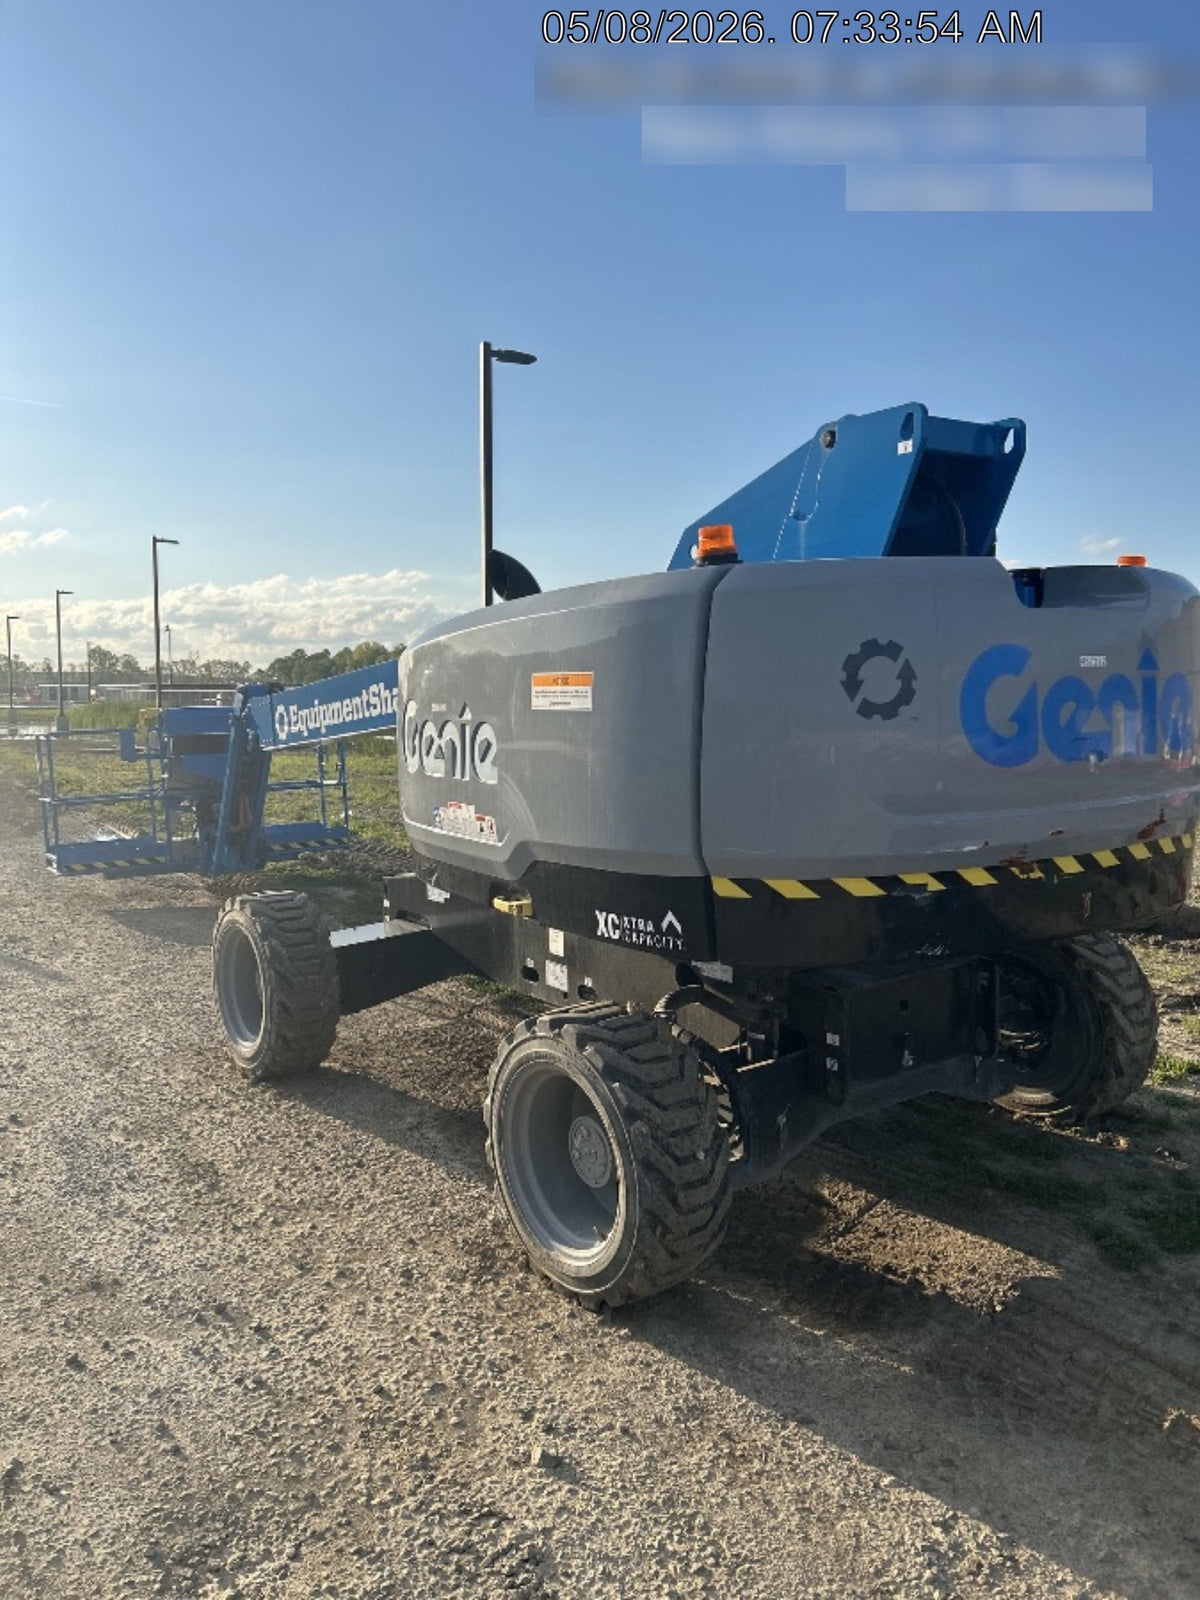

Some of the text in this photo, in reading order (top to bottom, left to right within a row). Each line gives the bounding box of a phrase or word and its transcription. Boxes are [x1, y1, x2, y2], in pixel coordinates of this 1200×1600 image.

[959, 643, 1193, 768] Genie
[403, 698, 499, 785] Genie
[595, 910, 620, 940] XC
[624, 929, 684, 950] CAPACITY
